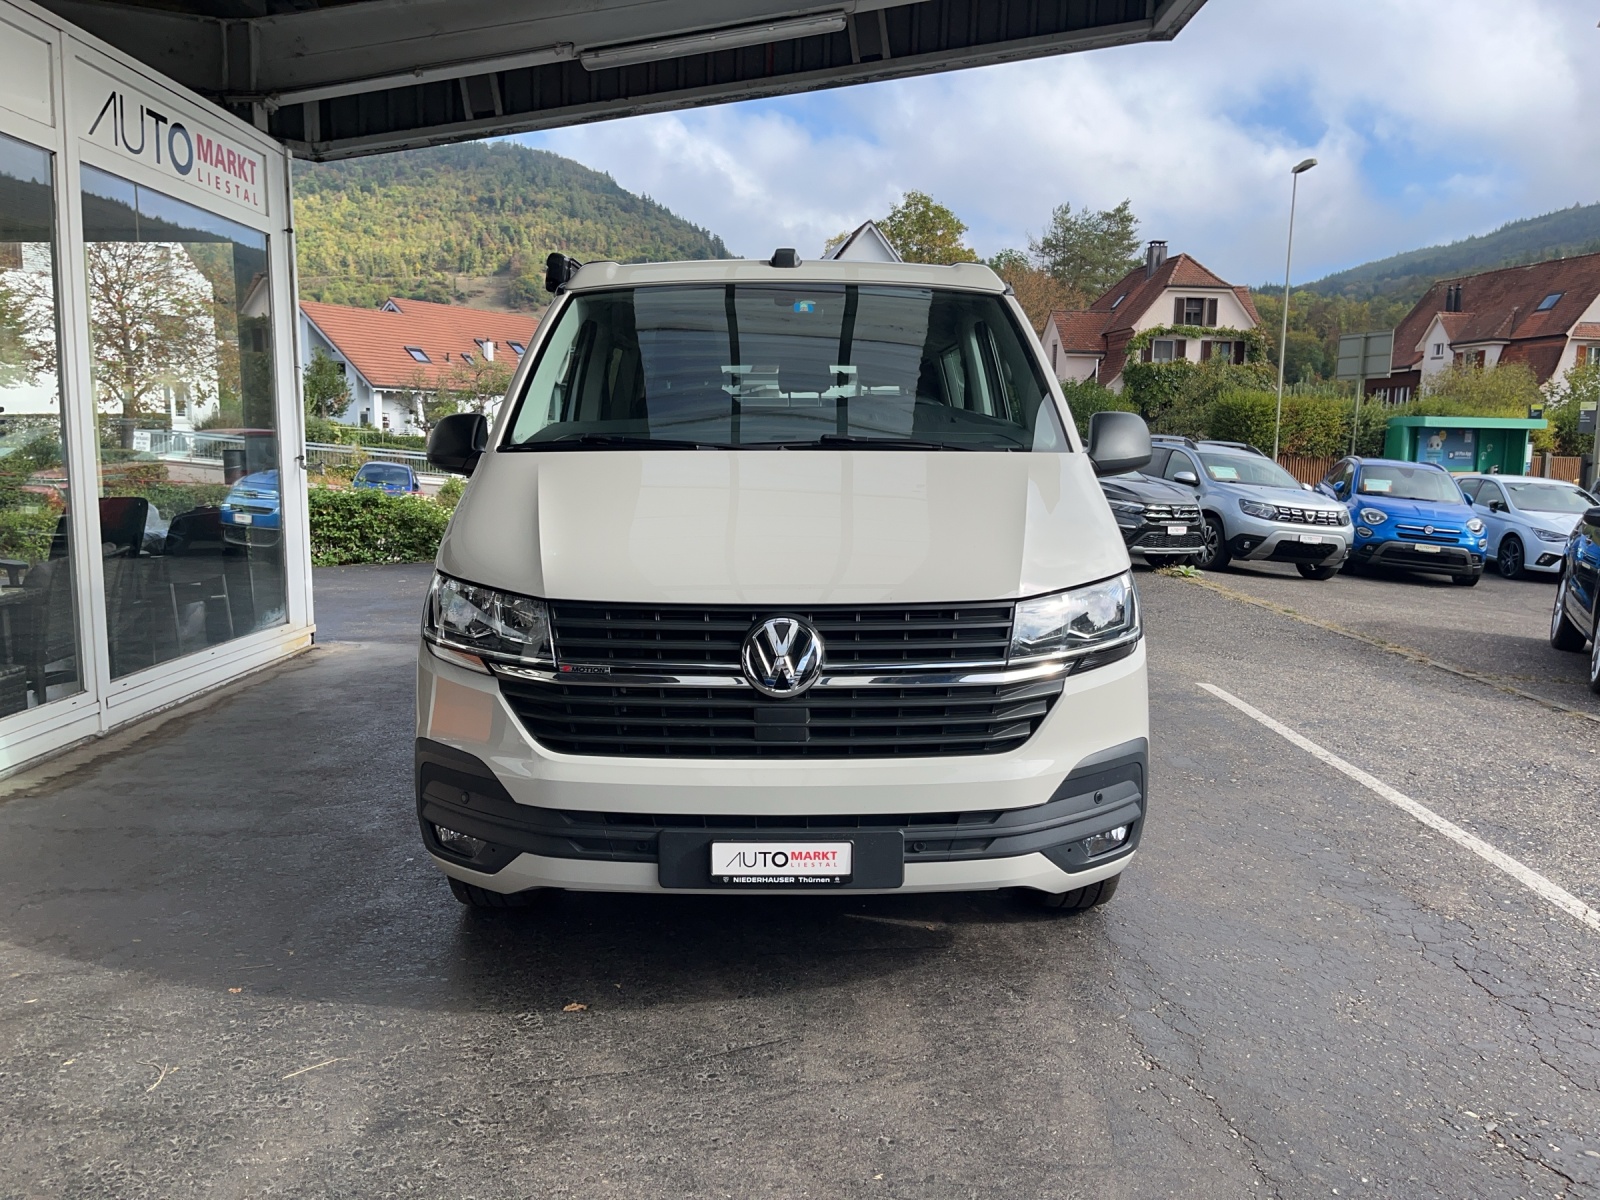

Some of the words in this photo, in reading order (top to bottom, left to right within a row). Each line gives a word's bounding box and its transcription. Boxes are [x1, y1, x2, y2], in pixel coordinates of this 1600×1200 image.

[88, 91, 194, 176] AUTO
[196, 133, 257, 185] MARKT
[197, 167, 259, 206] LIESTAL
[790, 851, 838, 861] MARKT
